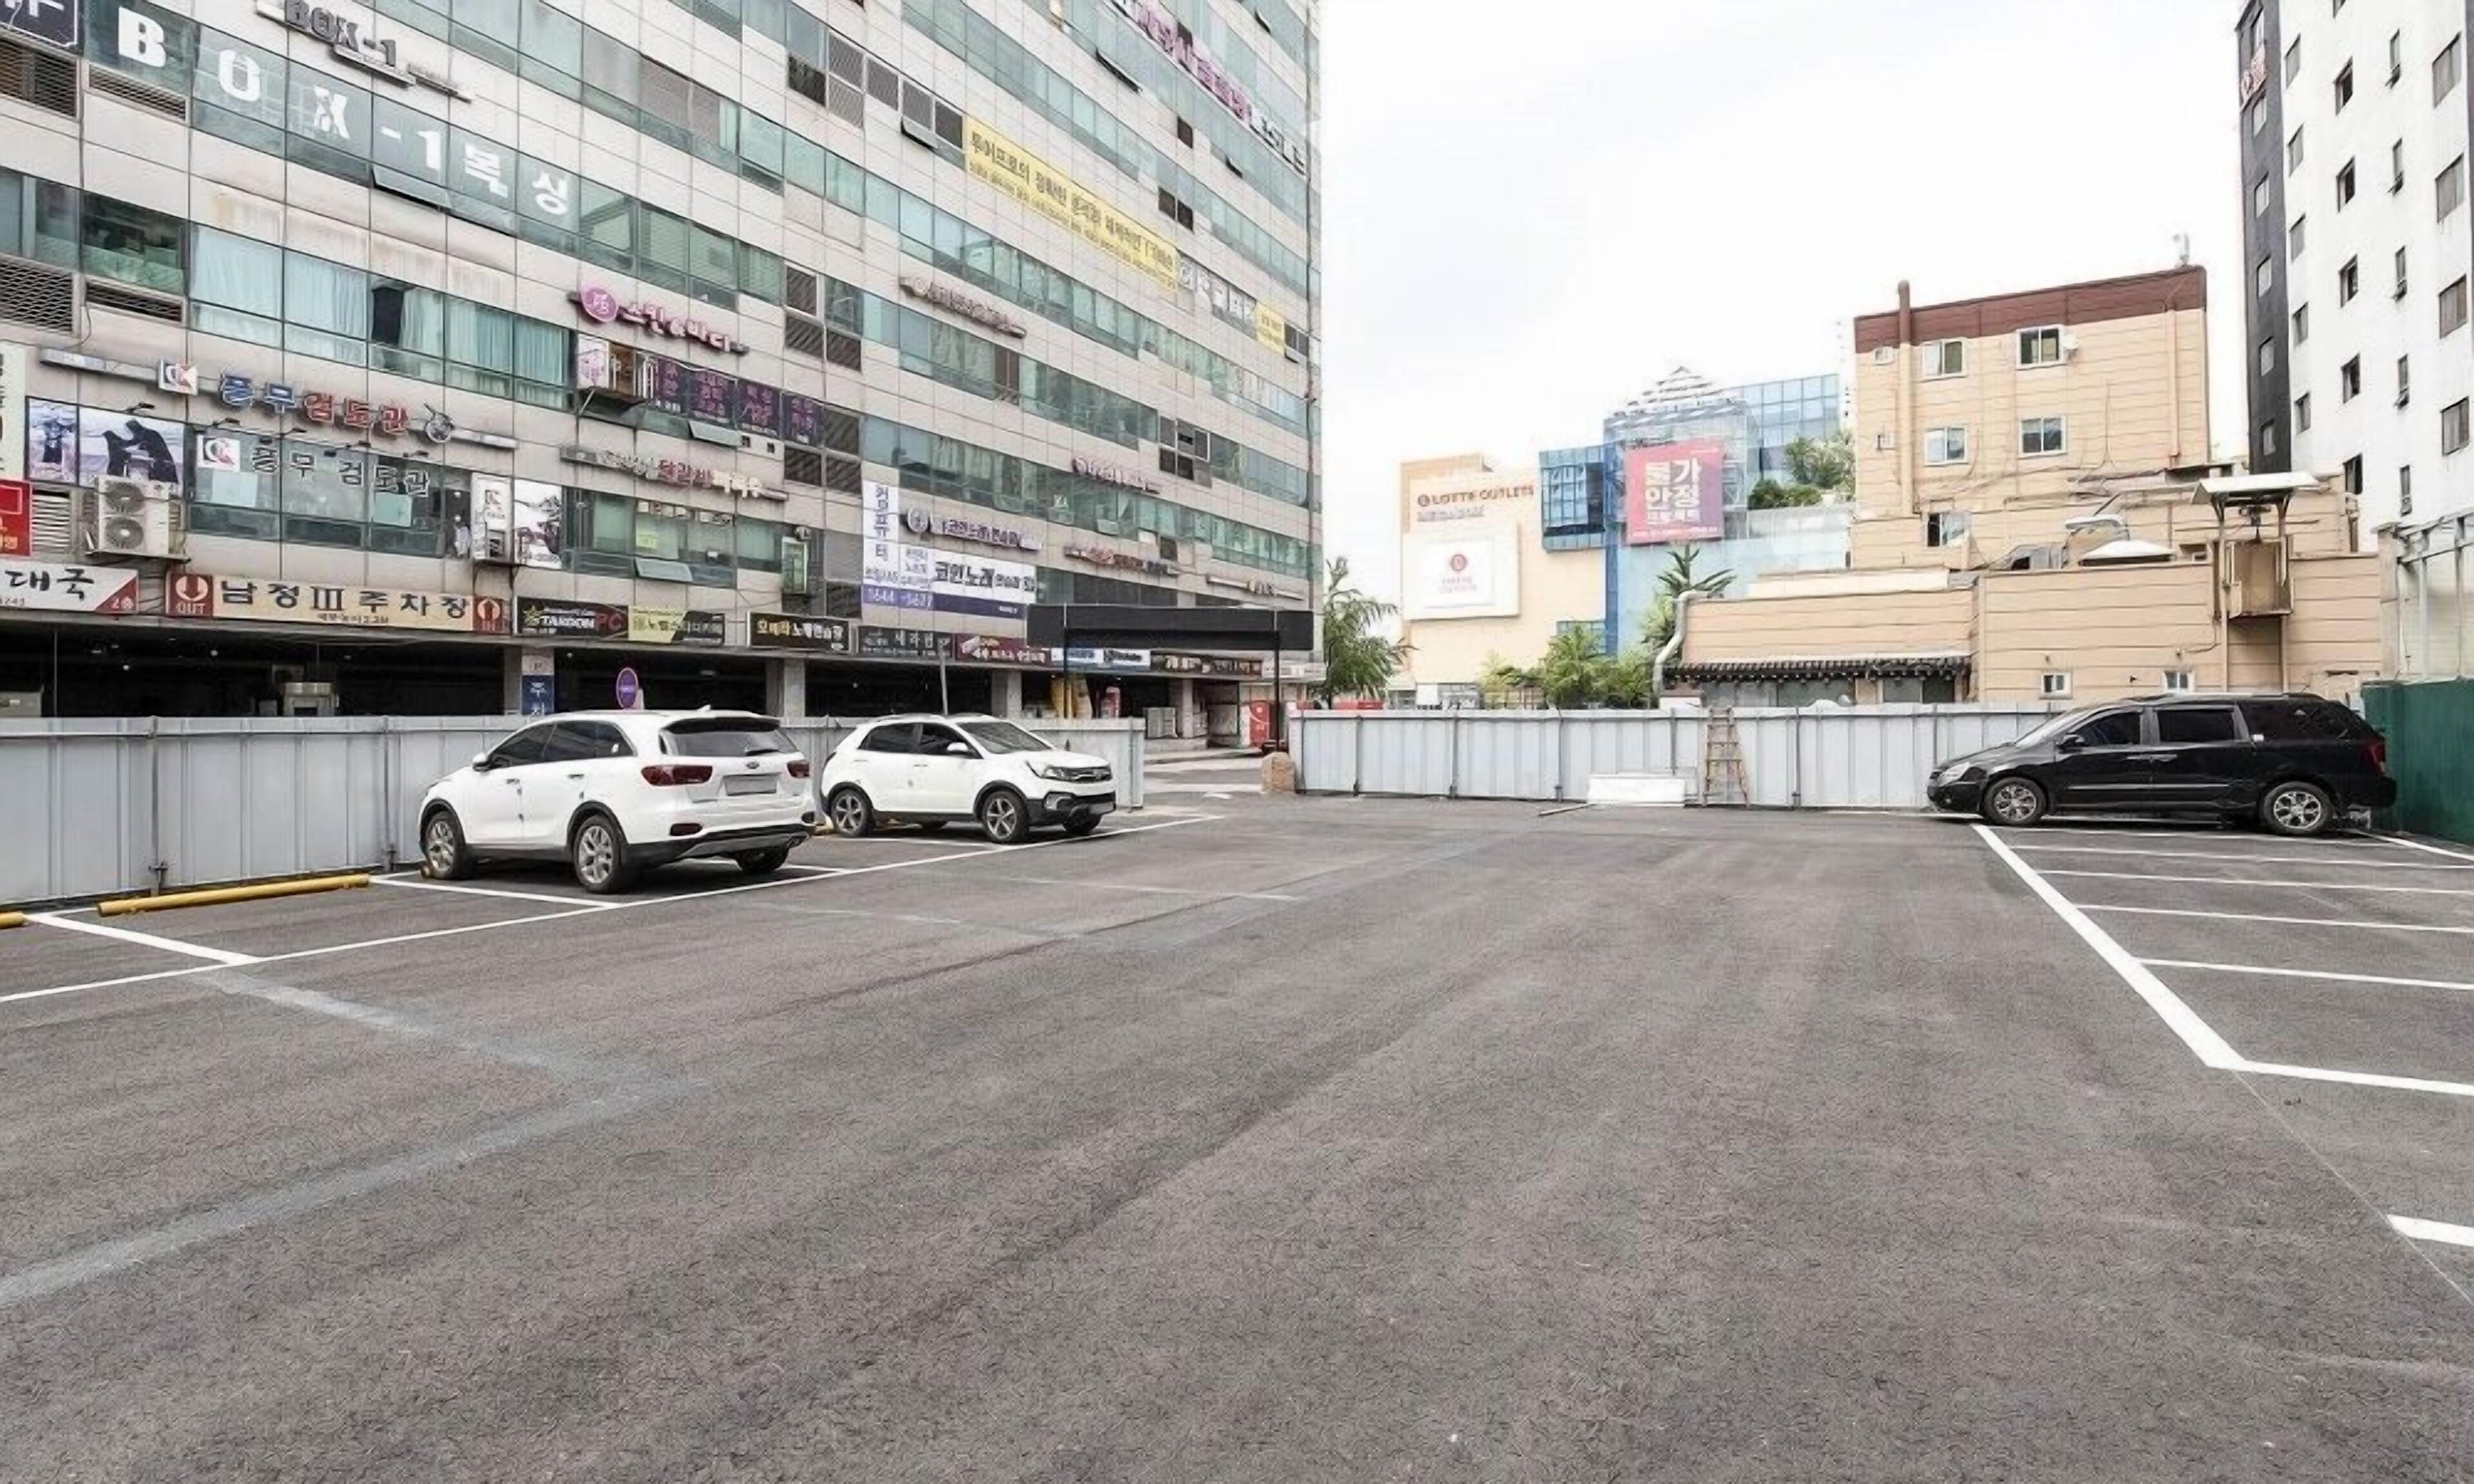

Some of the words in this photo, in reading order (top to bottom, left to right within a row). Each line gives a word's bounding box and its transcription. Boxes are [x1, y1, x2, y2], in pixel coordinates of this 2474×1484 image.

[1433, 491, 1475, 504] LOTTE
[1480, 484, 1534, 500] OUTLETS
[177, 602, 206, 614] OUT
[596, 613, 624, 631] PC
